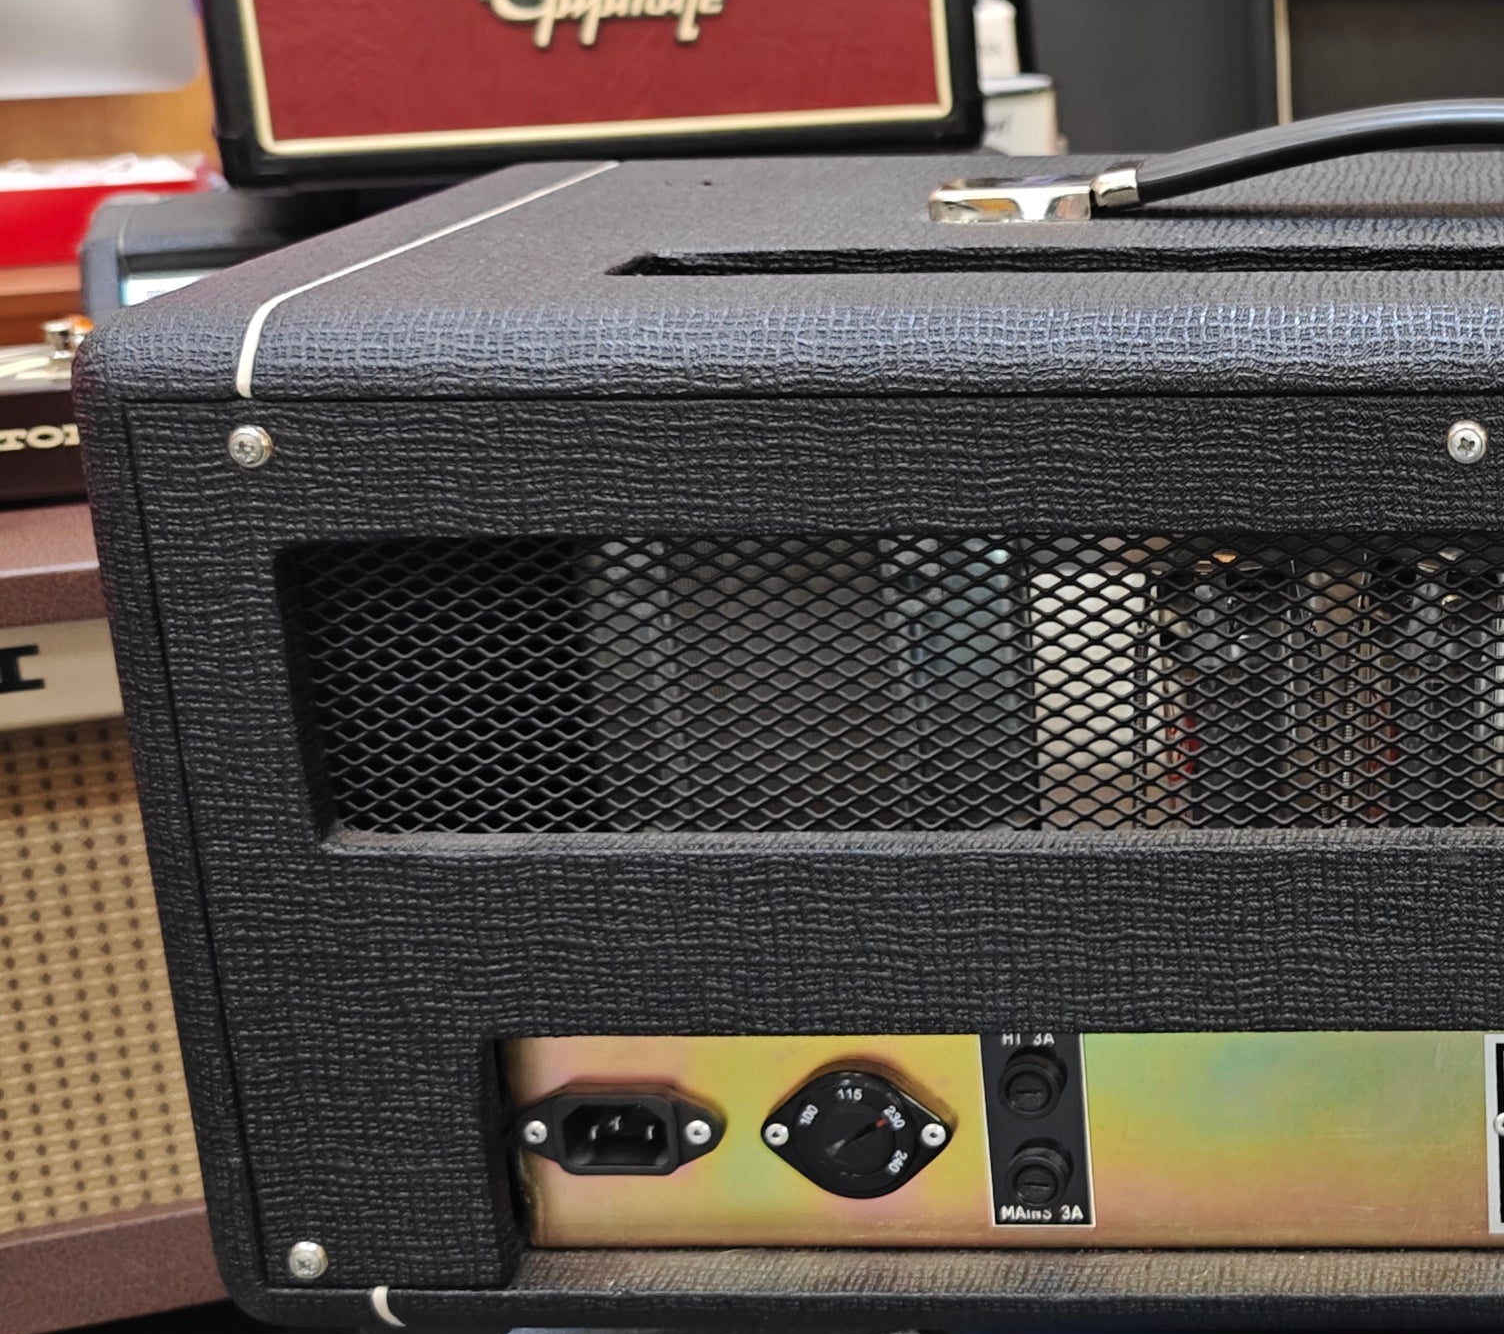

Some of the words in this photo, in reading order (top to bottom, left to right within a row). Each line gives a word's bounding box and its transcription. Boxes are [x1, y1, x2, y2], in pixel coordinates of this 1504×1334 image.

[800, 1104, 818, 1127] 100
[884, 1105, 905, 1130] 230
[887, 1149, 907, 1174] 240
[1060, 1205, 1084, 1220] 3A
